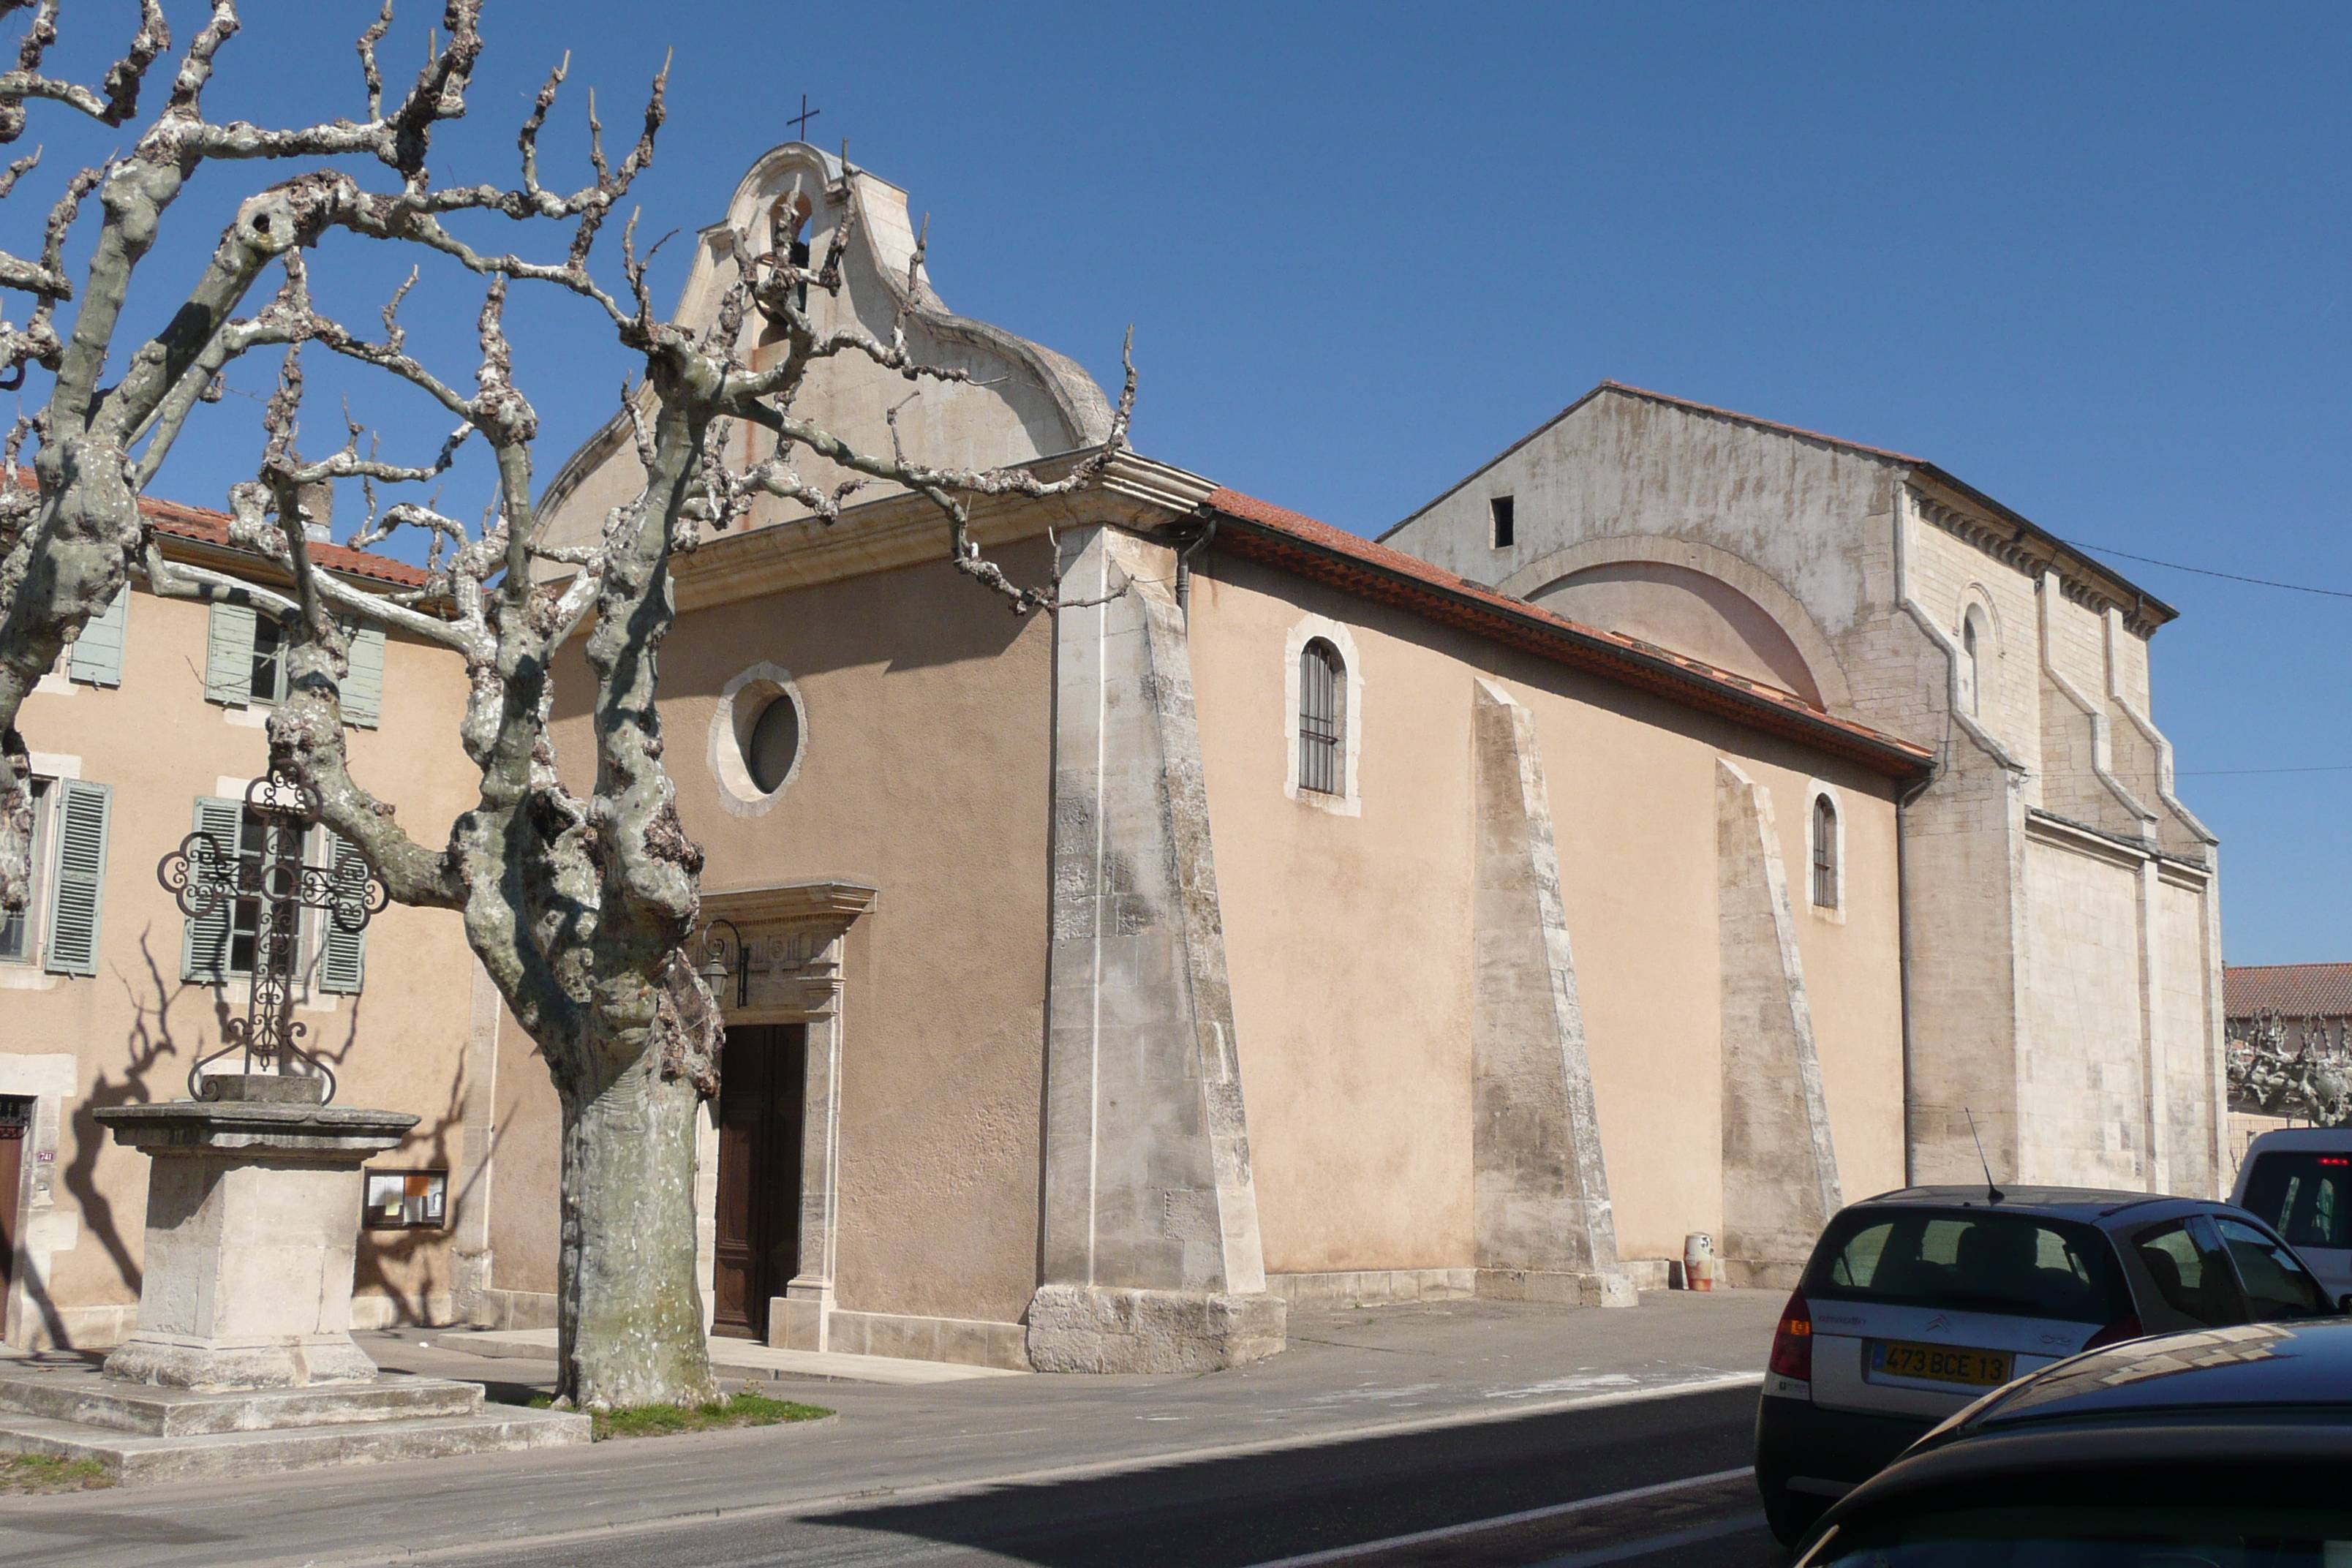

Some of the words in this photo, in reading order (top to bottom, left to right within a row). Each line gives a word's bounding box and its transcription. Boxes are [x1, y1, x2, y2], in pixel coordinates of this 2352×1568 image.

[1886, 1347, 1926, 1372] 473
[1930, 1353, 1971, 1377] BCE
[1978, 1357, 2003, 1381] 13
